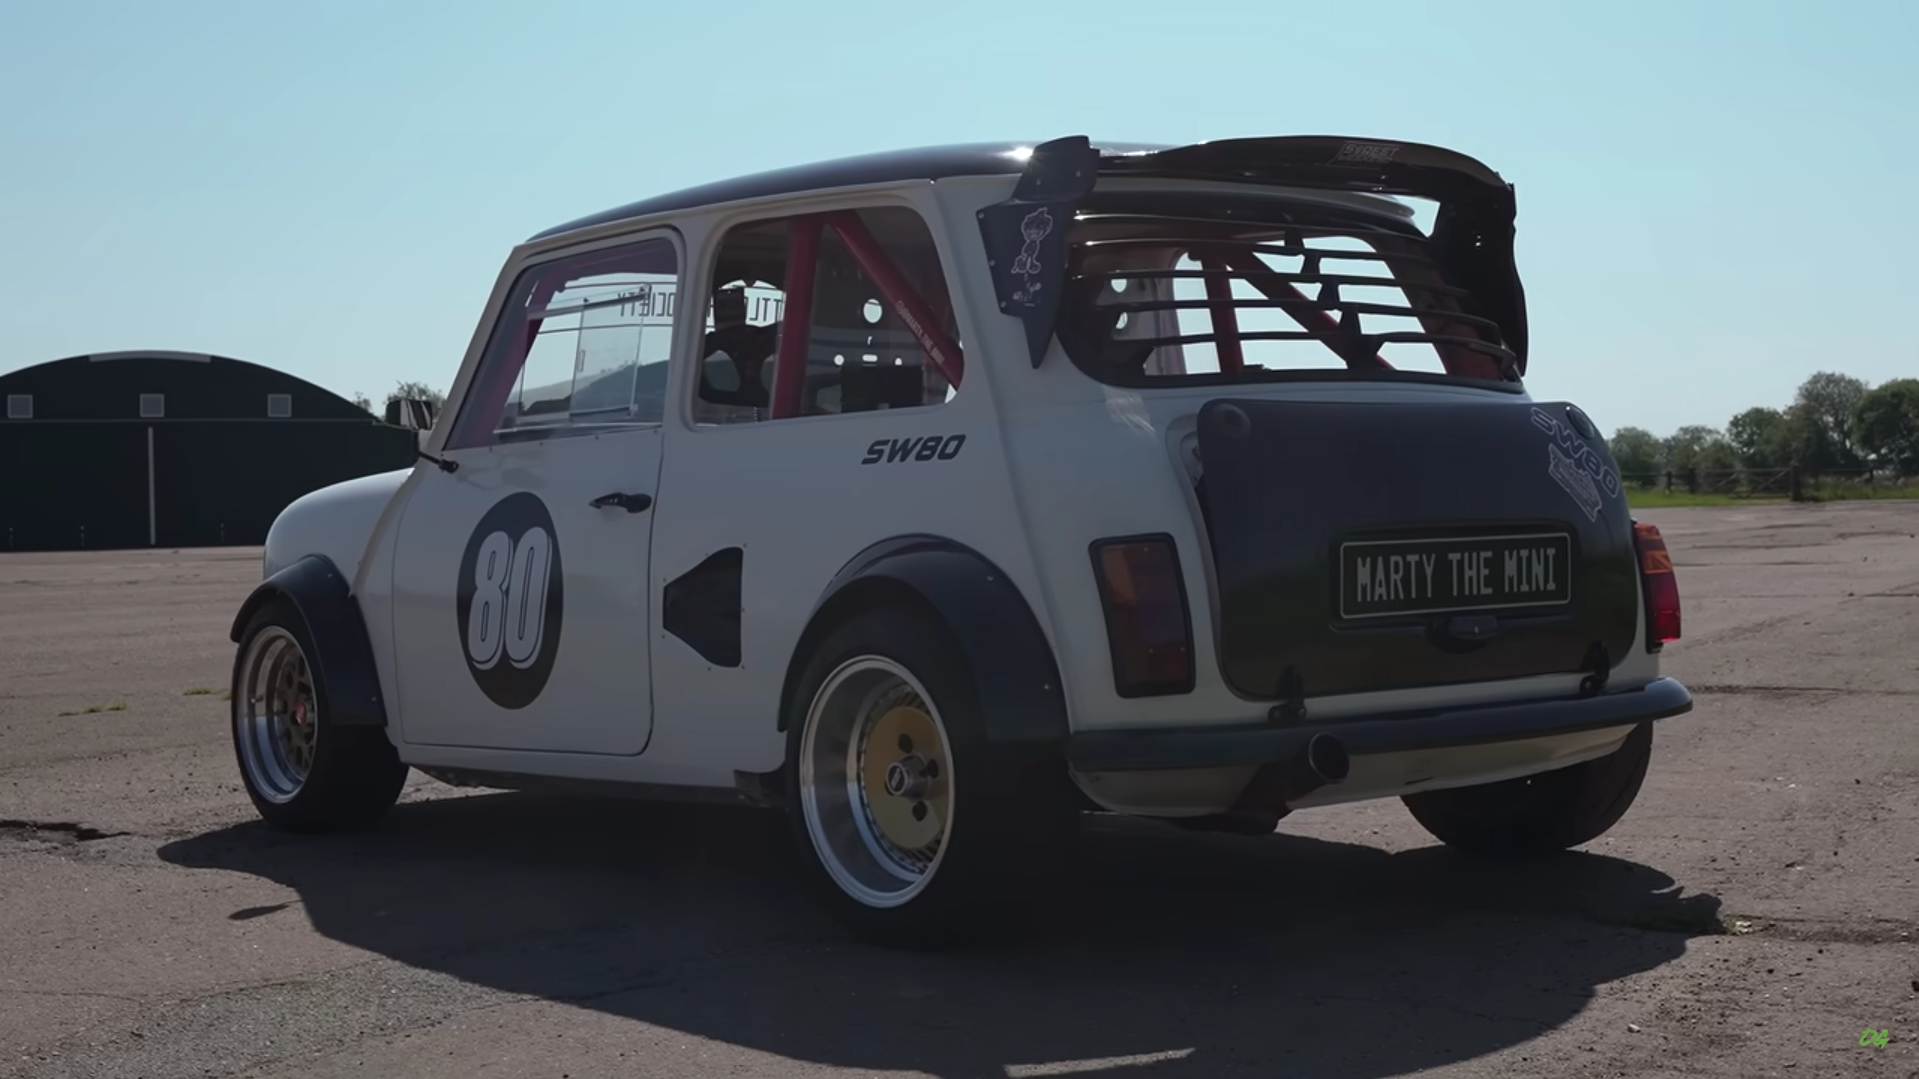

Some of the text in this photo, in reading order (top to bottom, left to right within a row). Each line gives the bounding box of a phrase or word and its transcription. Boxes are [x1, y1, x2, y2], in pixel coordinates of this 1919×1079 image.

[860, 433, 966, 465] SW80
[1531, 406, 1620, 498] SW80
[467, 526, 553, 671] 80
[1356, 547, 1557, 603] MARTY THE MINI
